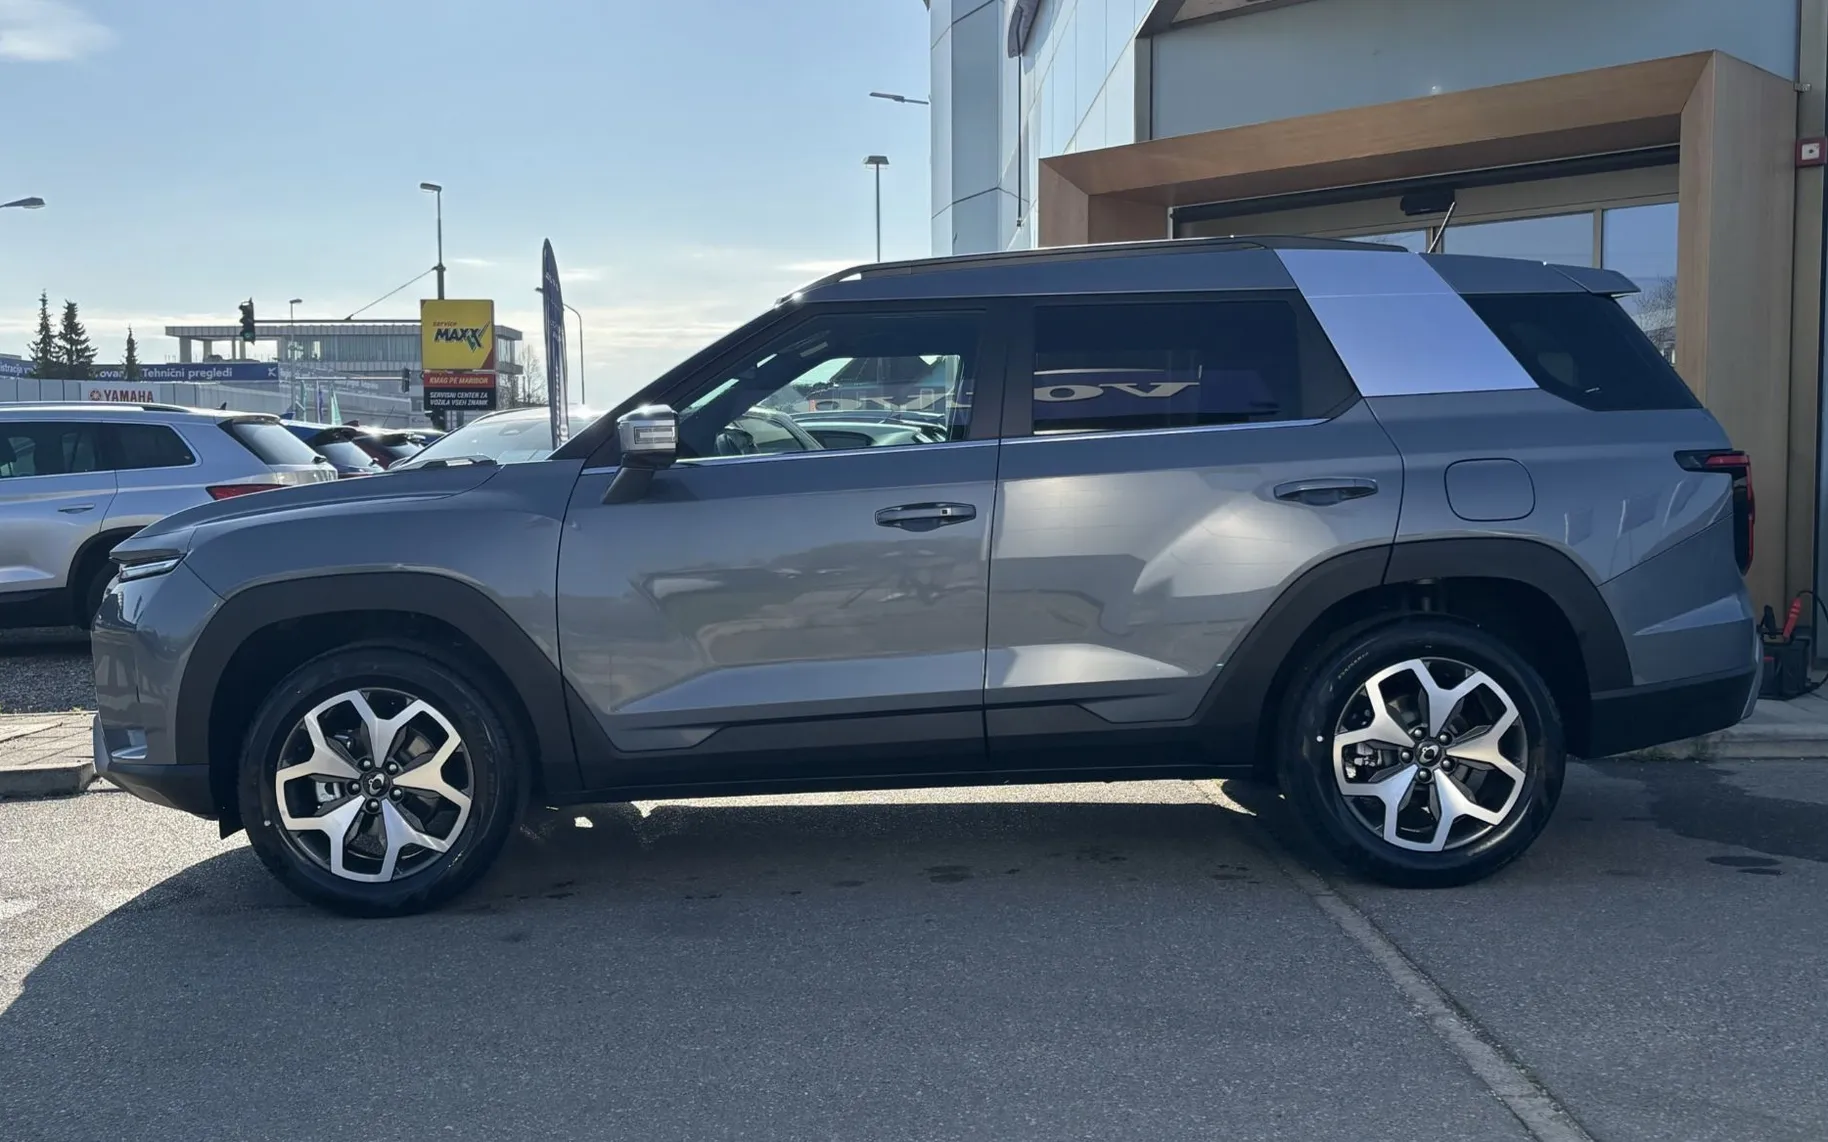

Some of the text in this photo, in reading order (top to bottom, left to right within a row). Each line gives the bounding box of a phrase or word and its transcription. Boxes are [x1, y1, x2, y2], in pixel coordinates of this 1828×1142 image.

[433, 327, 490, 353] MAXX
[142, 367, 233, 380] Tehnični pregledi
[448, 376, 459, 385] PE
[459, 376, 489, 385] MARIBOR
[104, 389, 154, 403] YAMAHA
[429, 391, 488, 399] SERVISNI CENTER ZA
